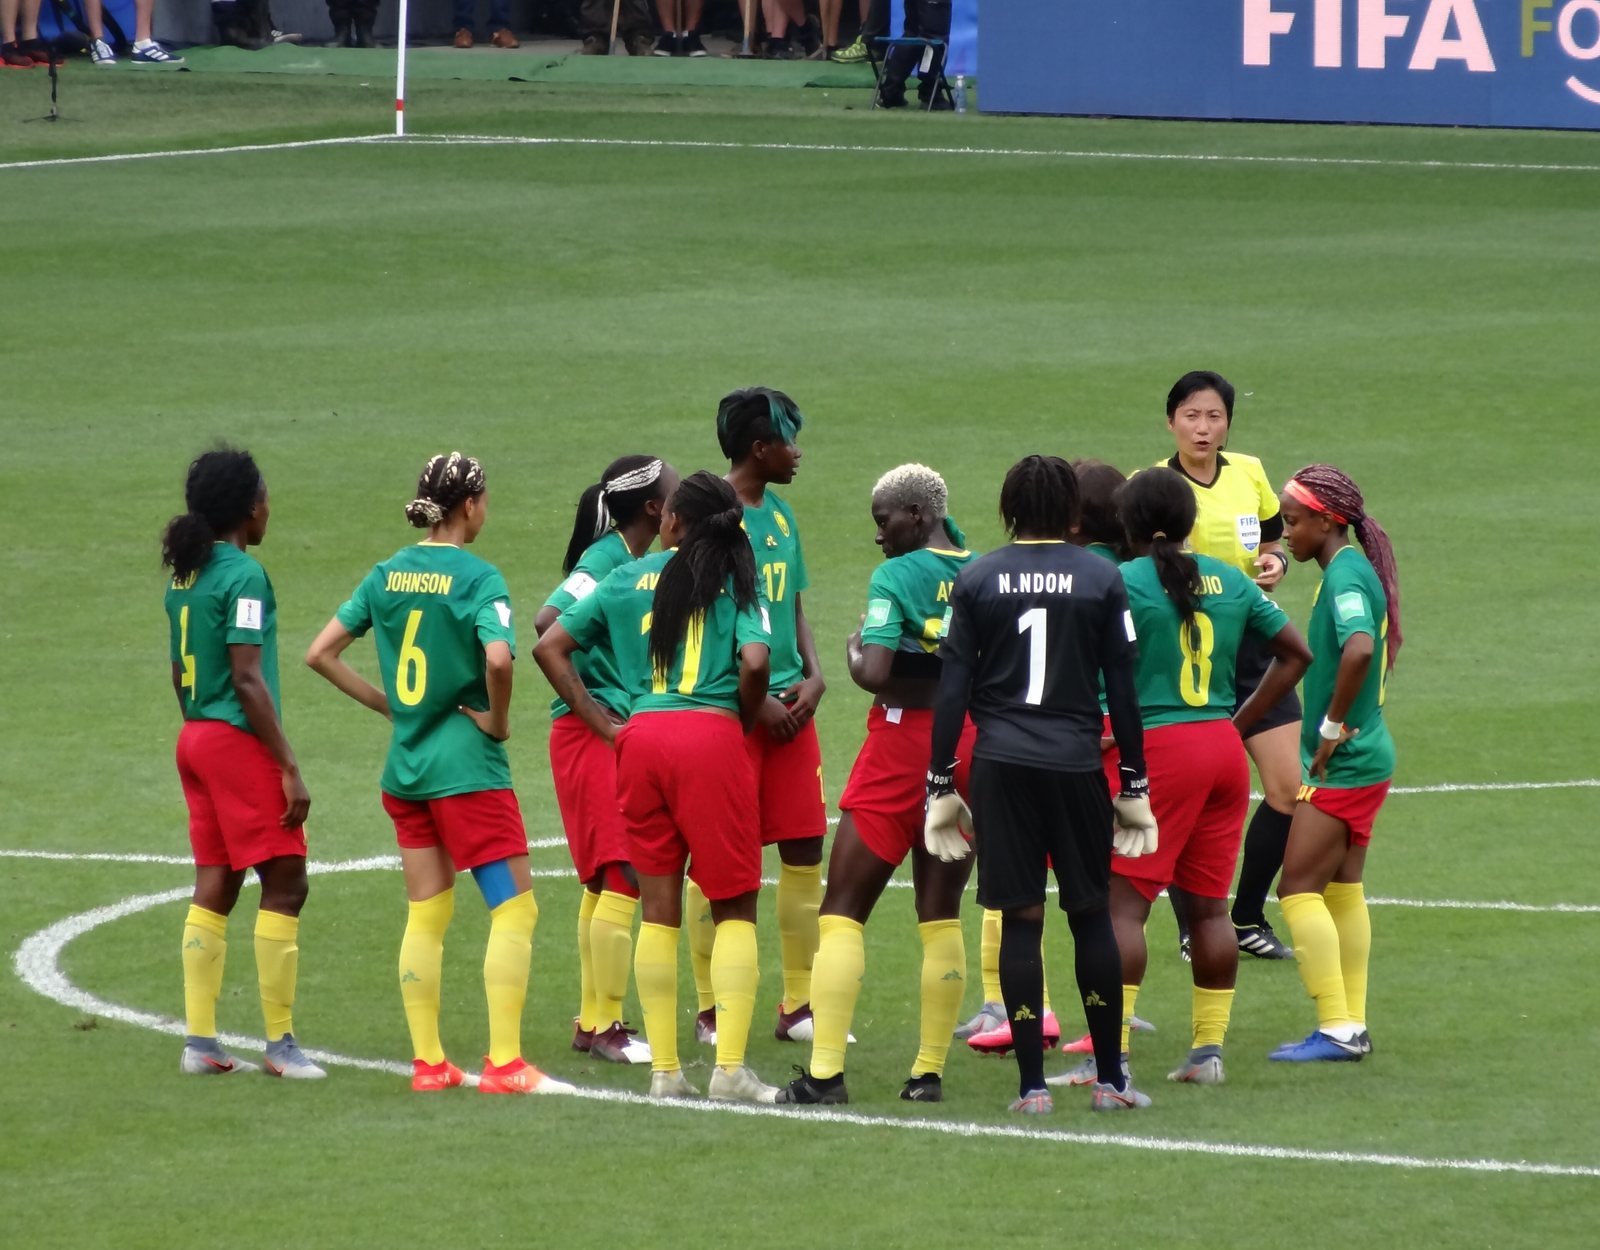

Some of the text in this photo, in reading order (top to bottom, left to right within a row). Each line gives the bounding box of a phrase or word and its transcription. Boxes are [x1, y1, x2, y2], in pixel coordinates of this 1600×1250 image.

[1242, 0, 1496, 72] FIFA
[1240, 516, 1258, 526] FIFA
[385, 571, 453, 595] JOHNSON
[763, 562, 787, 602] 17
[999, 573, 1073, 594] N.NDOM
[396, 609, 427, 706] 6
[1019, 608, 1047, 706] 1
[1179, 612, 1215, 708] 8
